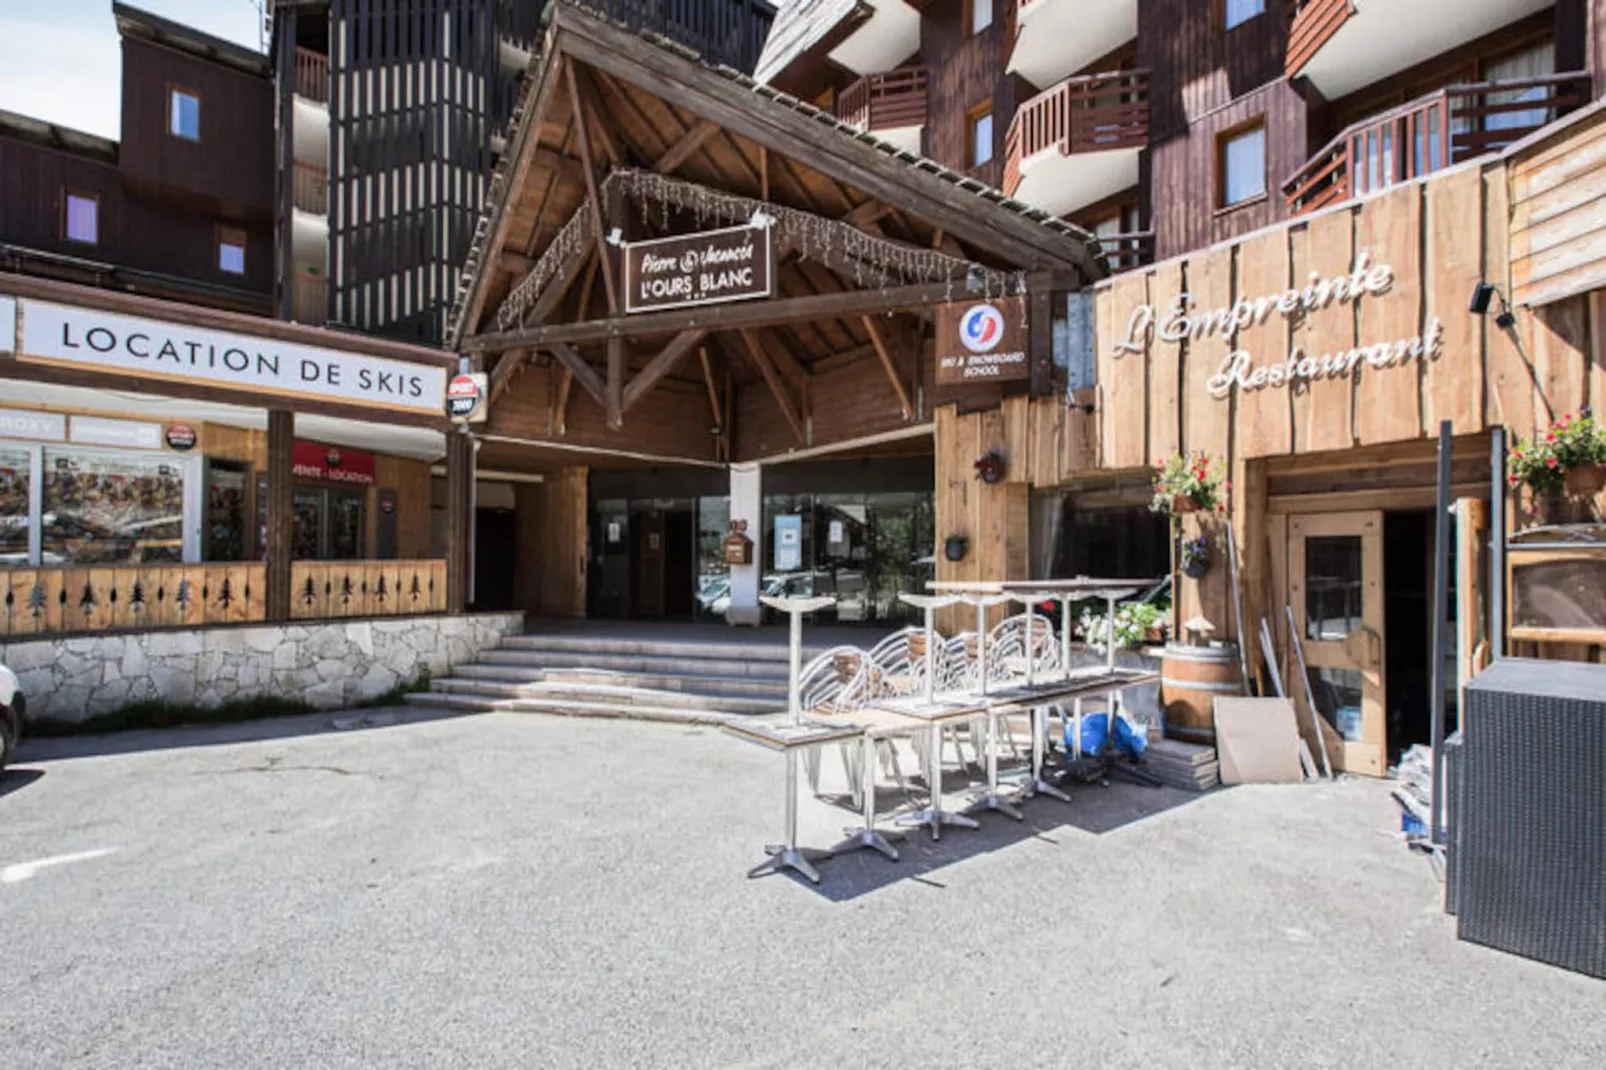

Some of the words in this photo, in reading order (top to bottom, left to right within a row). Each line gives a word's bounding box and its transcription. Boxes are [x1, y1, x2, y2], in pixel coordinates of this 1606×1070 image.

[641, 276, 692, 299] L'OURS
[700, 268, 753, 292] BLANC
[1113, 251, 1394, 357] L'Empreinte
[62, 322, 280, 376] LOCATION
[300, 359, 341, 385] DE
[358, 368, 424, 397] SKIS
[1206, 316, 1445, 399] Restaurant
